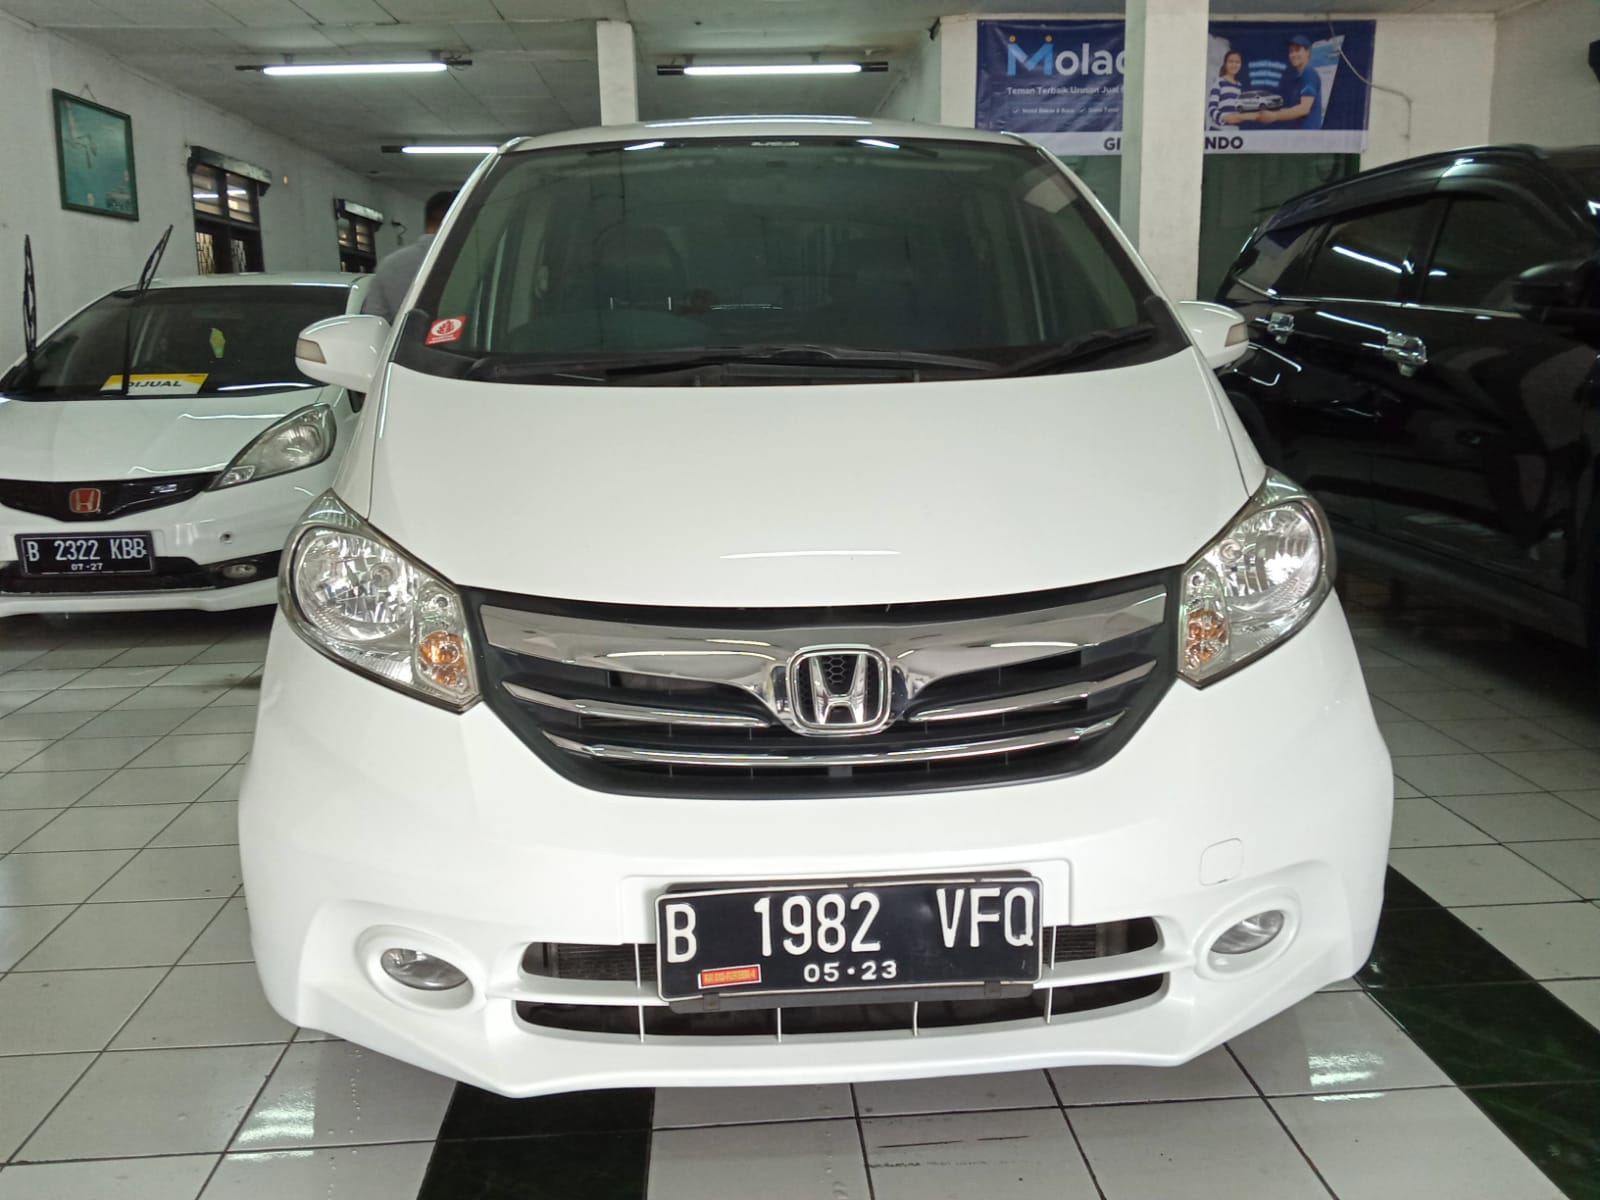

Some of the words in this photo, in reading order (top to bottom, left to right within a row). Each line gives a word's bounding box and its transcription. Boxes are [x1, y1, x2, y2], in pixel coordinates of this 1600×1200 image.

[26, 541, 40, 562] B
[54, 540, 101, 561] 2322
[110, 538, 147, 559] KBB
[665, 903, 697, 964] B
[754, 892, 881, 957] 1982
[936, 887, 1034, 948] VFQ
